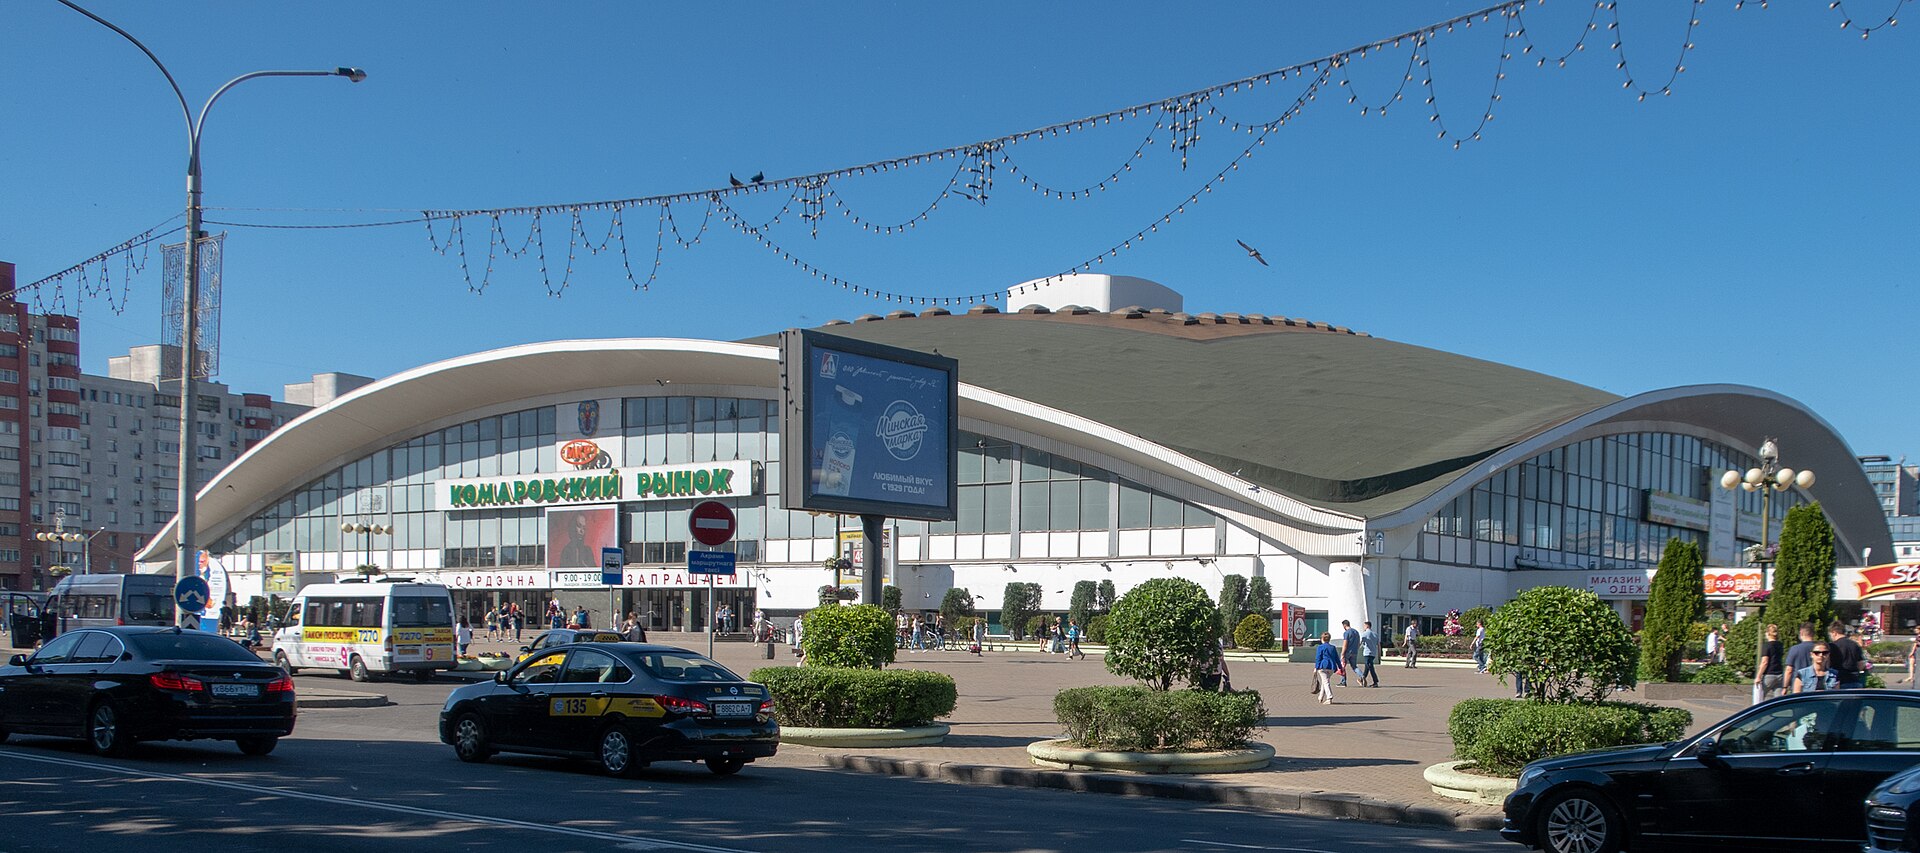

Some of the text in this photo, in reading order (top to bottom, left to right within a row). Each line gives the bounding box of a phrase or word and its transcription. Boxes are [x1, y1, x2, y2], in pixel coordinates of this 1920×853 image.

[876, 413, 926, 437] Минская
[889, 430, 922, 449] марка
[873, 472, 933, 486] ЛЮБИМЫЙ ВКУС
[450, 468, 733, 505] КОМАРОВСКИЙ РЫНОК
[903, 486, 925, 494] ГОДА!
[456, 573, 737, 587] САРДЭЧНА ЗАПРАШАЕМ
[564, 574, 577, 582] 9.00
[1591, 576, 1641, 584] МАГАЗИН
[1888, 565, 1920, 584] St
[1715, 580, 1735, 588] 5.99
[358, 630, 378, 642] 7270
[399, 632, 422, 640] 7270
[341, 646, 348, 667] 9
[426, 648, 433, 660] 9
[566, 699, 587, 714] 135
